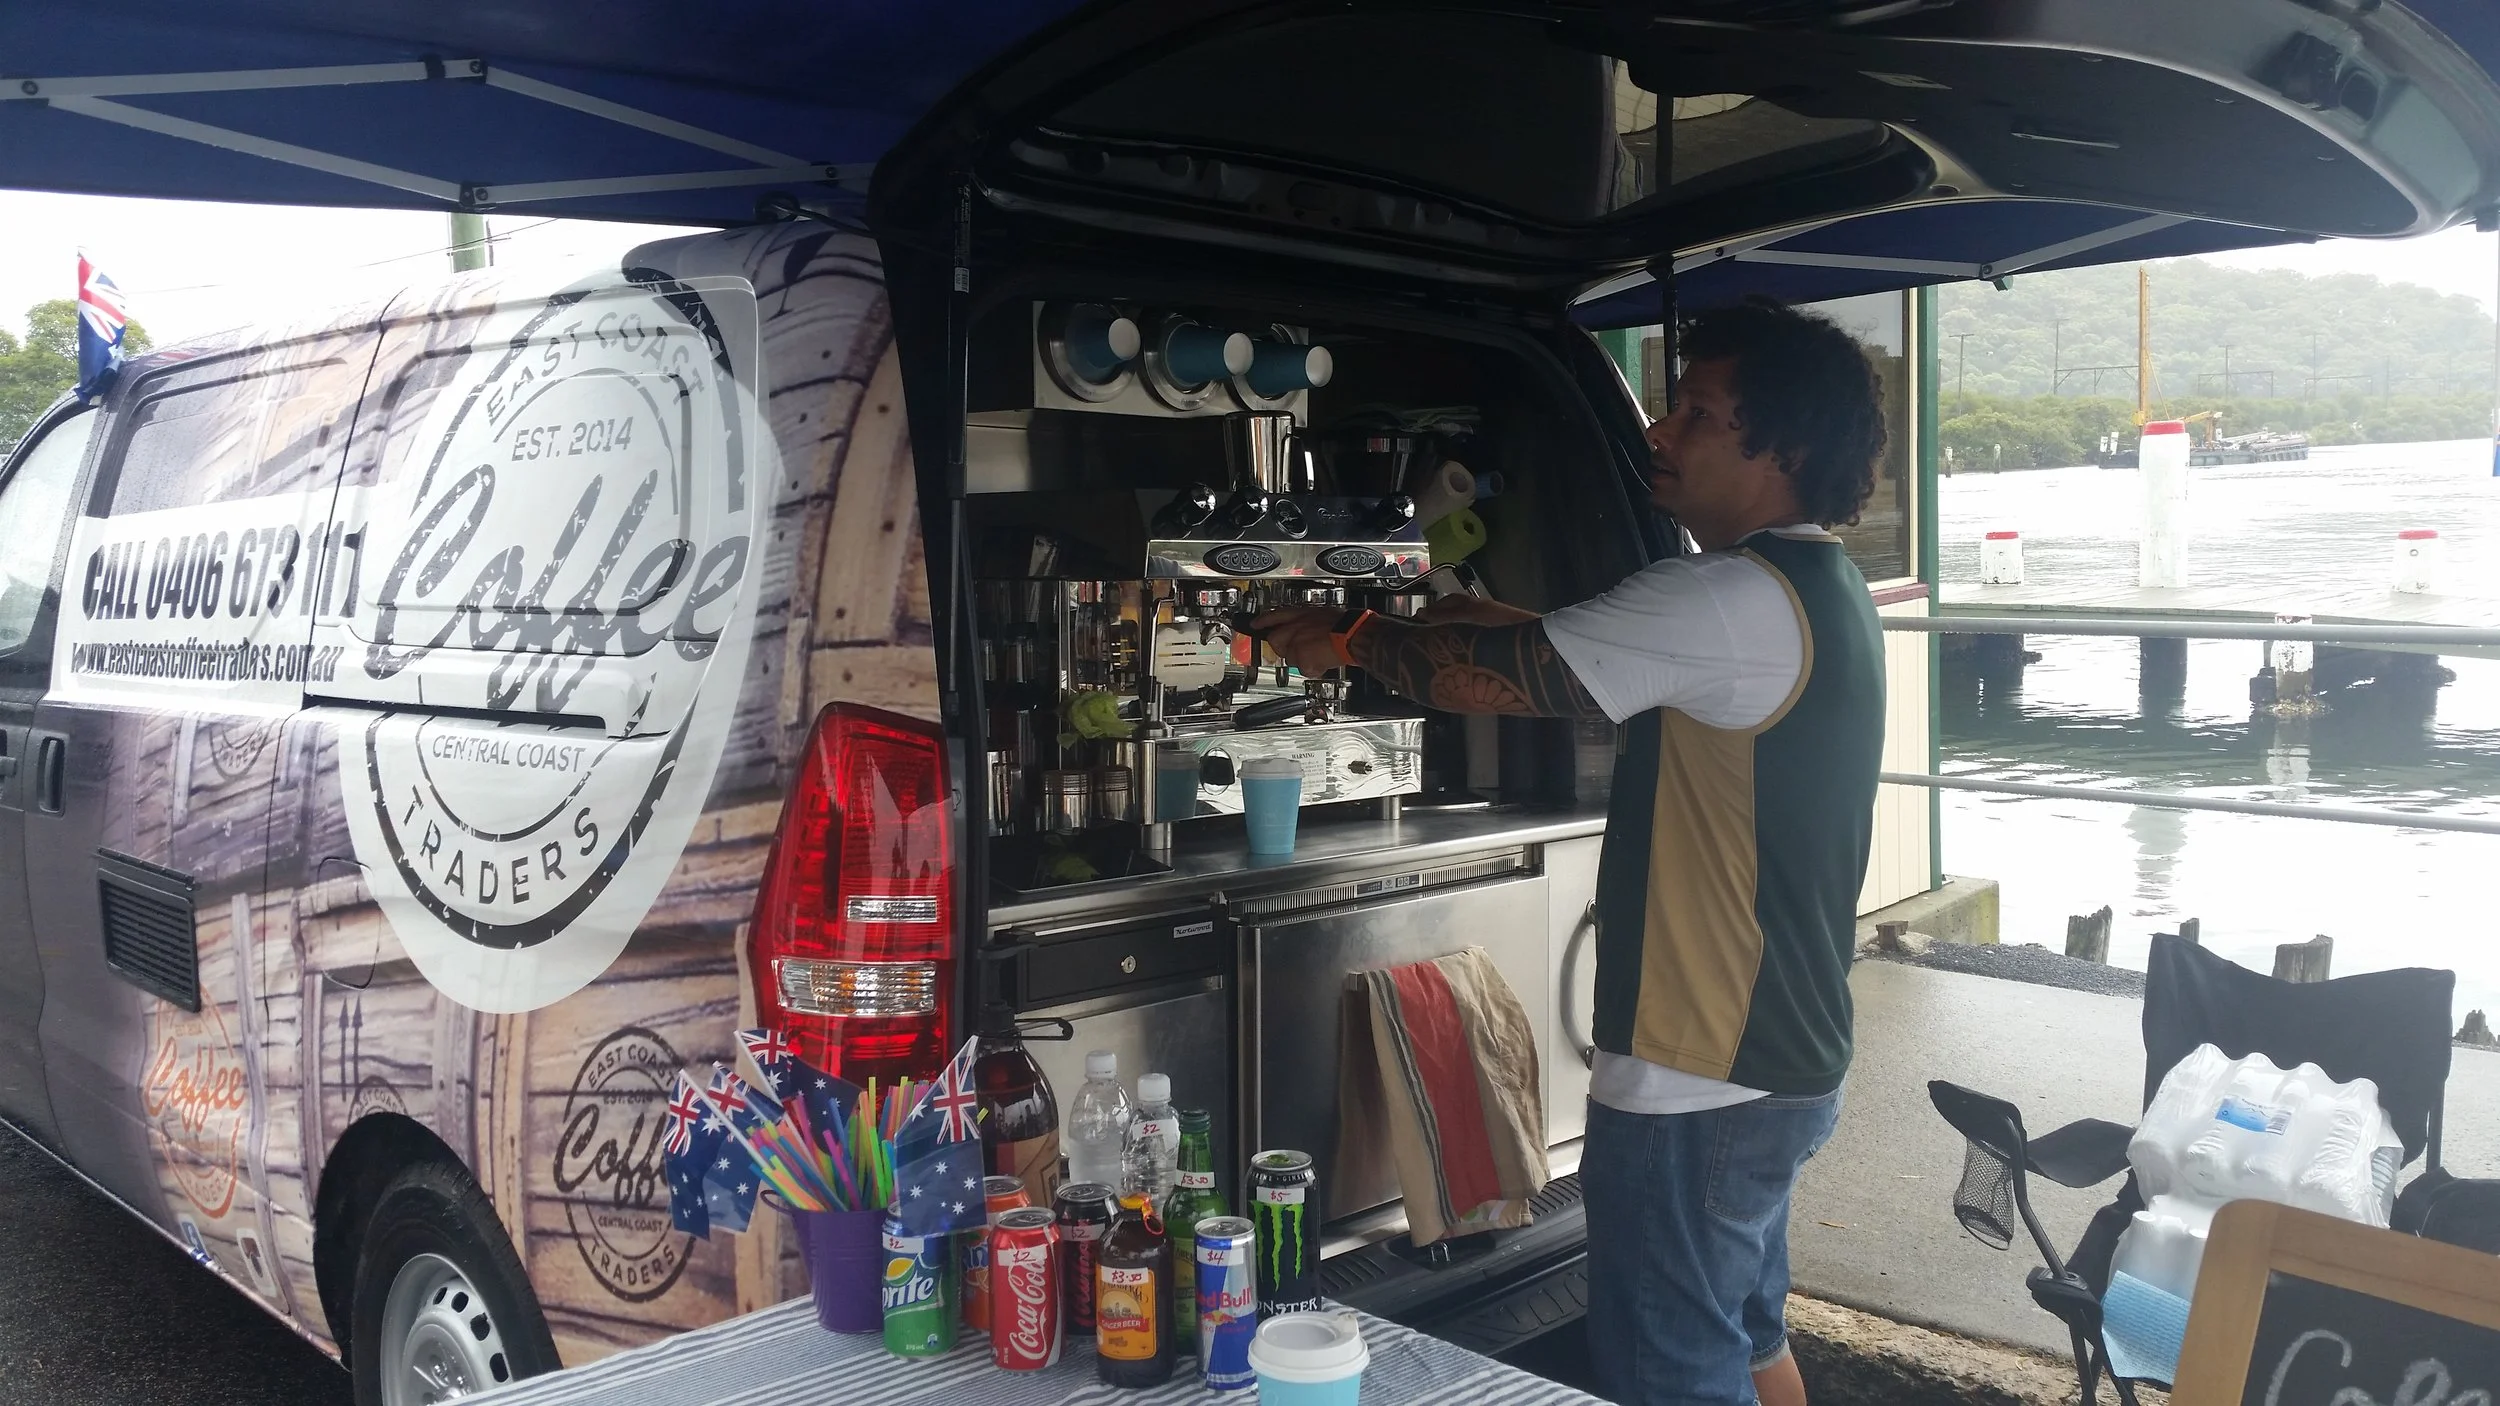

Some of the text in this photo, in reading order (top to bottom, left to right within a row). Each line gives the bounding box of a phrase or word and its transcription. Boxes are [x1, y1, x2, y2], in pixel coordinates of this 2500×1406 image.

[486, 311, 706, 427] EAST COAST
[511, 415, 634, 462] EST. 2014
[82, 520, 369, 621] CALL 0406 673 111
[363, 464, 750, 712] Coffee
[432, 734, 587, 774] CENTRAL COAST
[403, 784, 600, 905] TRADERS
[144, 1036, 245, 1134] Coffee
[587, 1043, 676, 1089] EAST COAST
[1143, 1123, 1160, 1135] $2
[598, 1215, 664, 1232] CENTRAL COAST
[889, 1239, 904, 1249] $2
[590, 1236, 676, 1287] TRADERS
[1207, 1250, 1224, 1265] $4
[882, 1269, 934, 1312] prite
[1221, 1288, 1252, 1308] Bull
[1122, 1320, 1141, 1328] BEER
